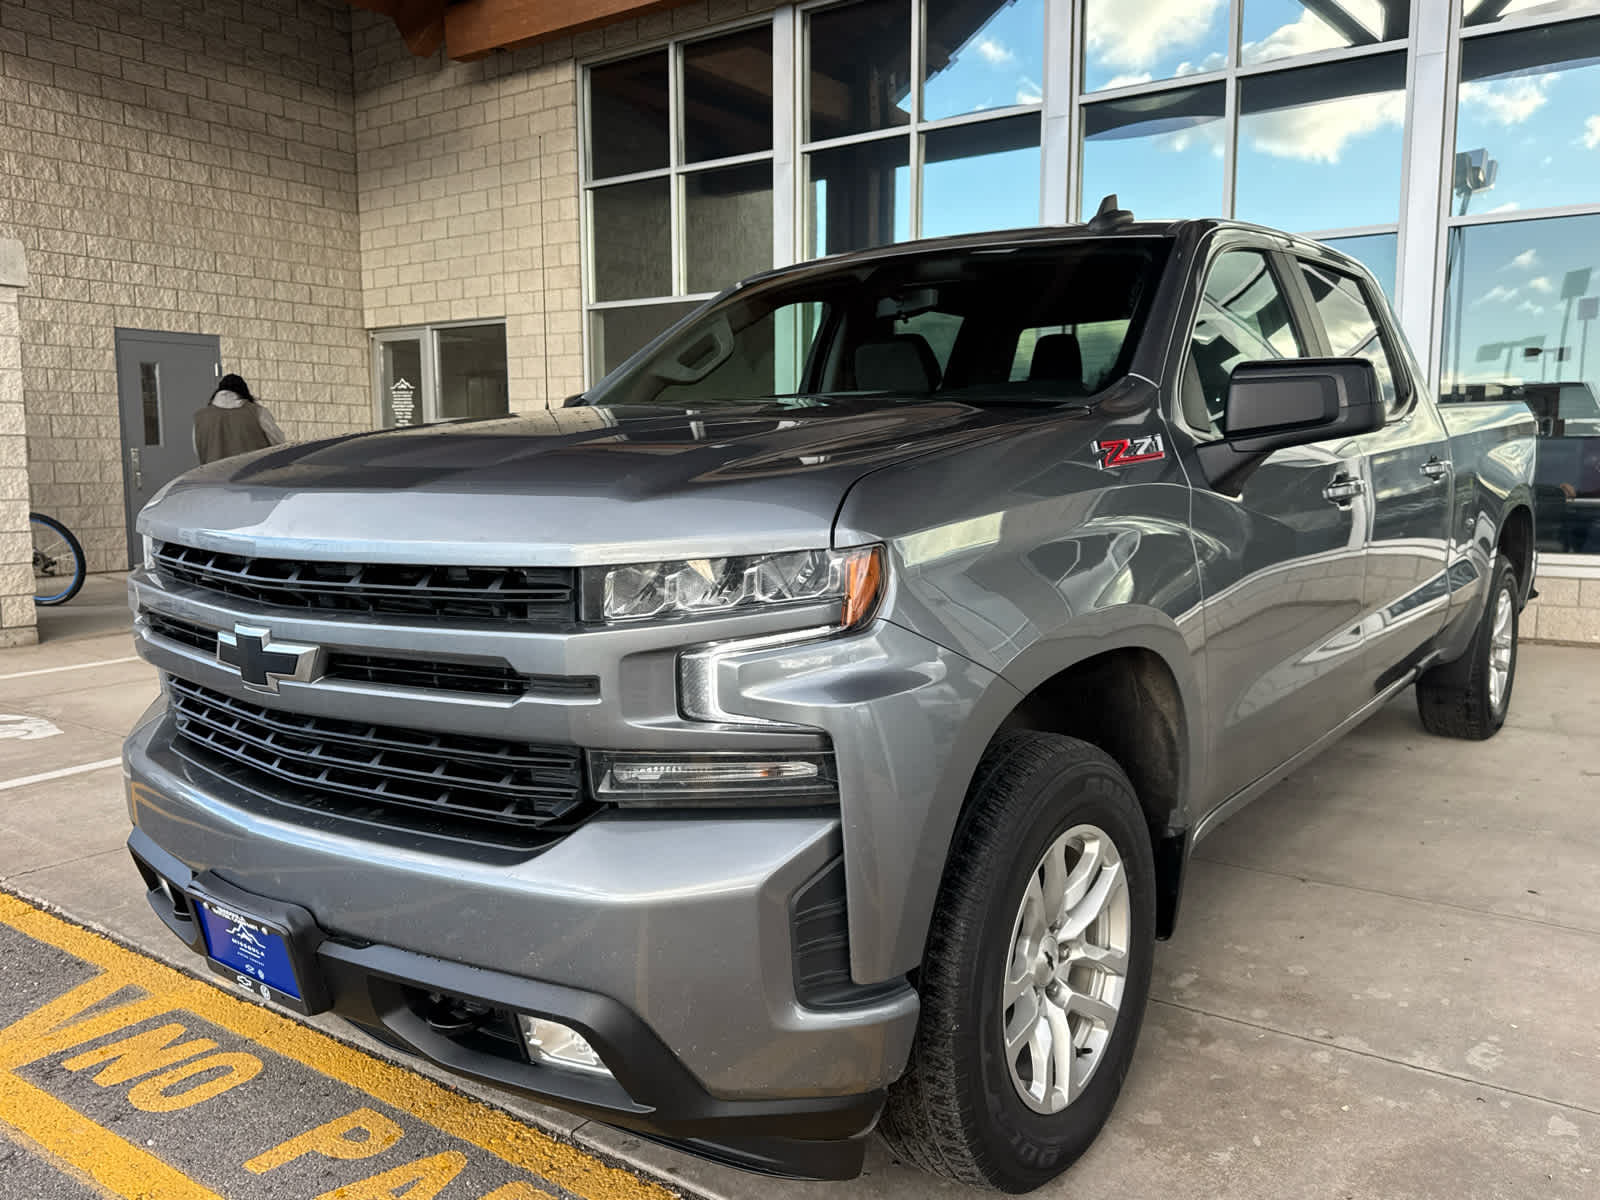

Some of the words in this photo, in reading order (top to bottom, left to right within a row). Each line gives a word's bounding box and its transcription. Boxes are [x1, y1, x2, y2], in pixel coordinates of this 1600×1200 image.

[1098, 433, 1165, 468] Z71
[61, 1022, 263, 1113] NO
[242, 1107, 559, 1200] PA
